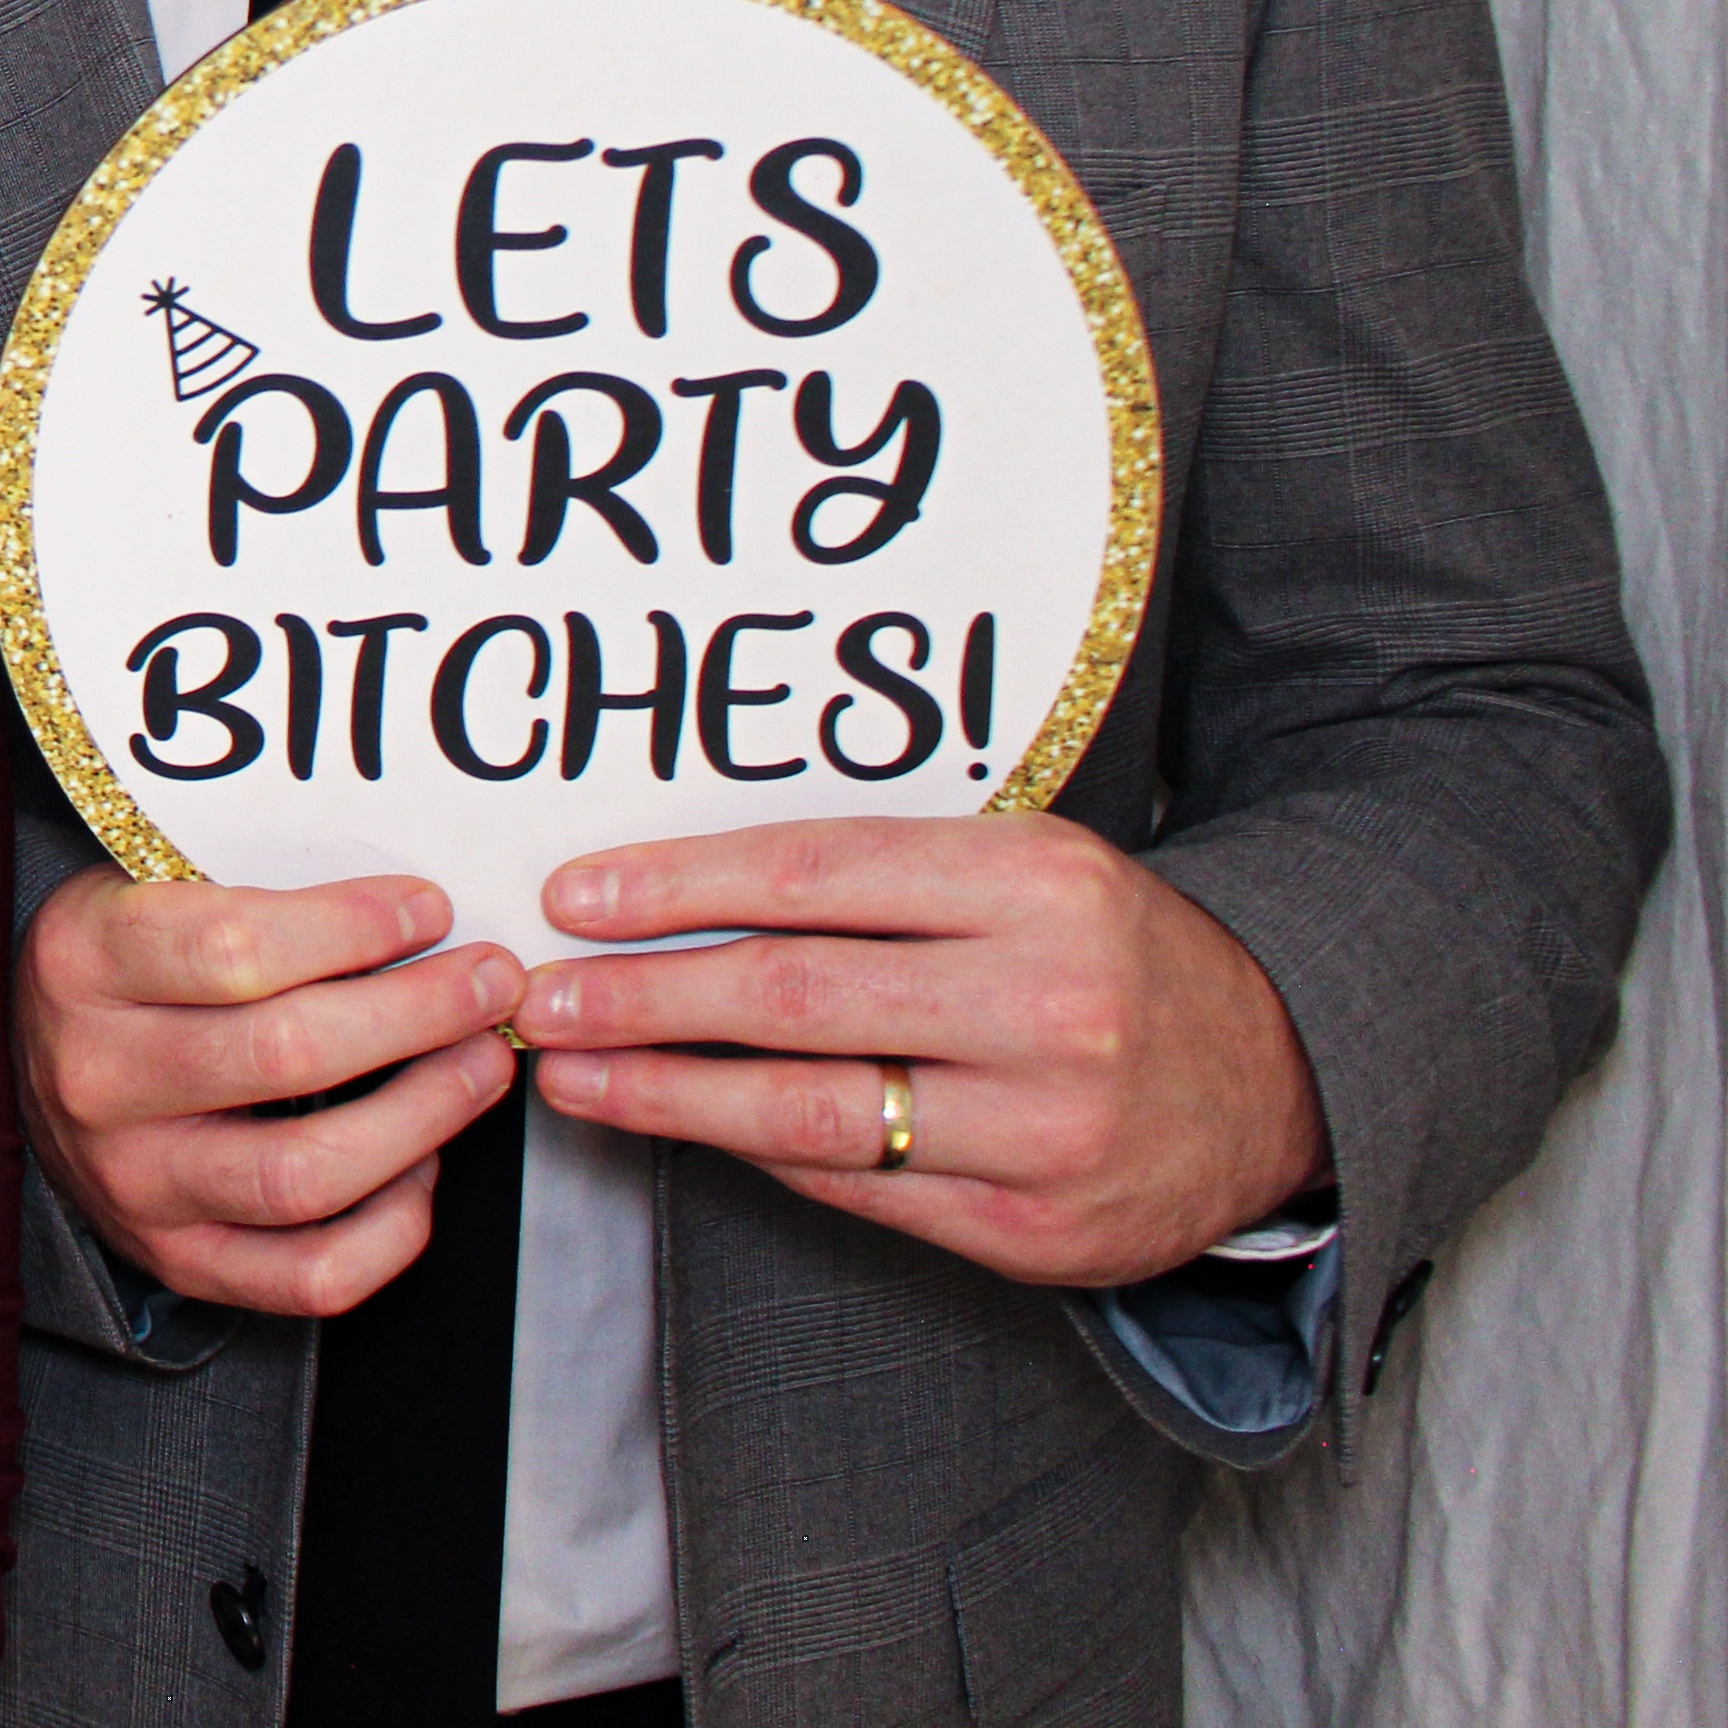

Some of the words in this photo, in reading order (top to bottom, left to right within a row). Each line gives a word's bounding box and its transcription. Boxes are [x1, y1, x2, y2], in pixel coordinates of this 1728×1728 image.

[307, 137, 882, 340] LETS
[192, 368, 943, 568] PARTY
[125, 609, 997, 783] BITCHES!
